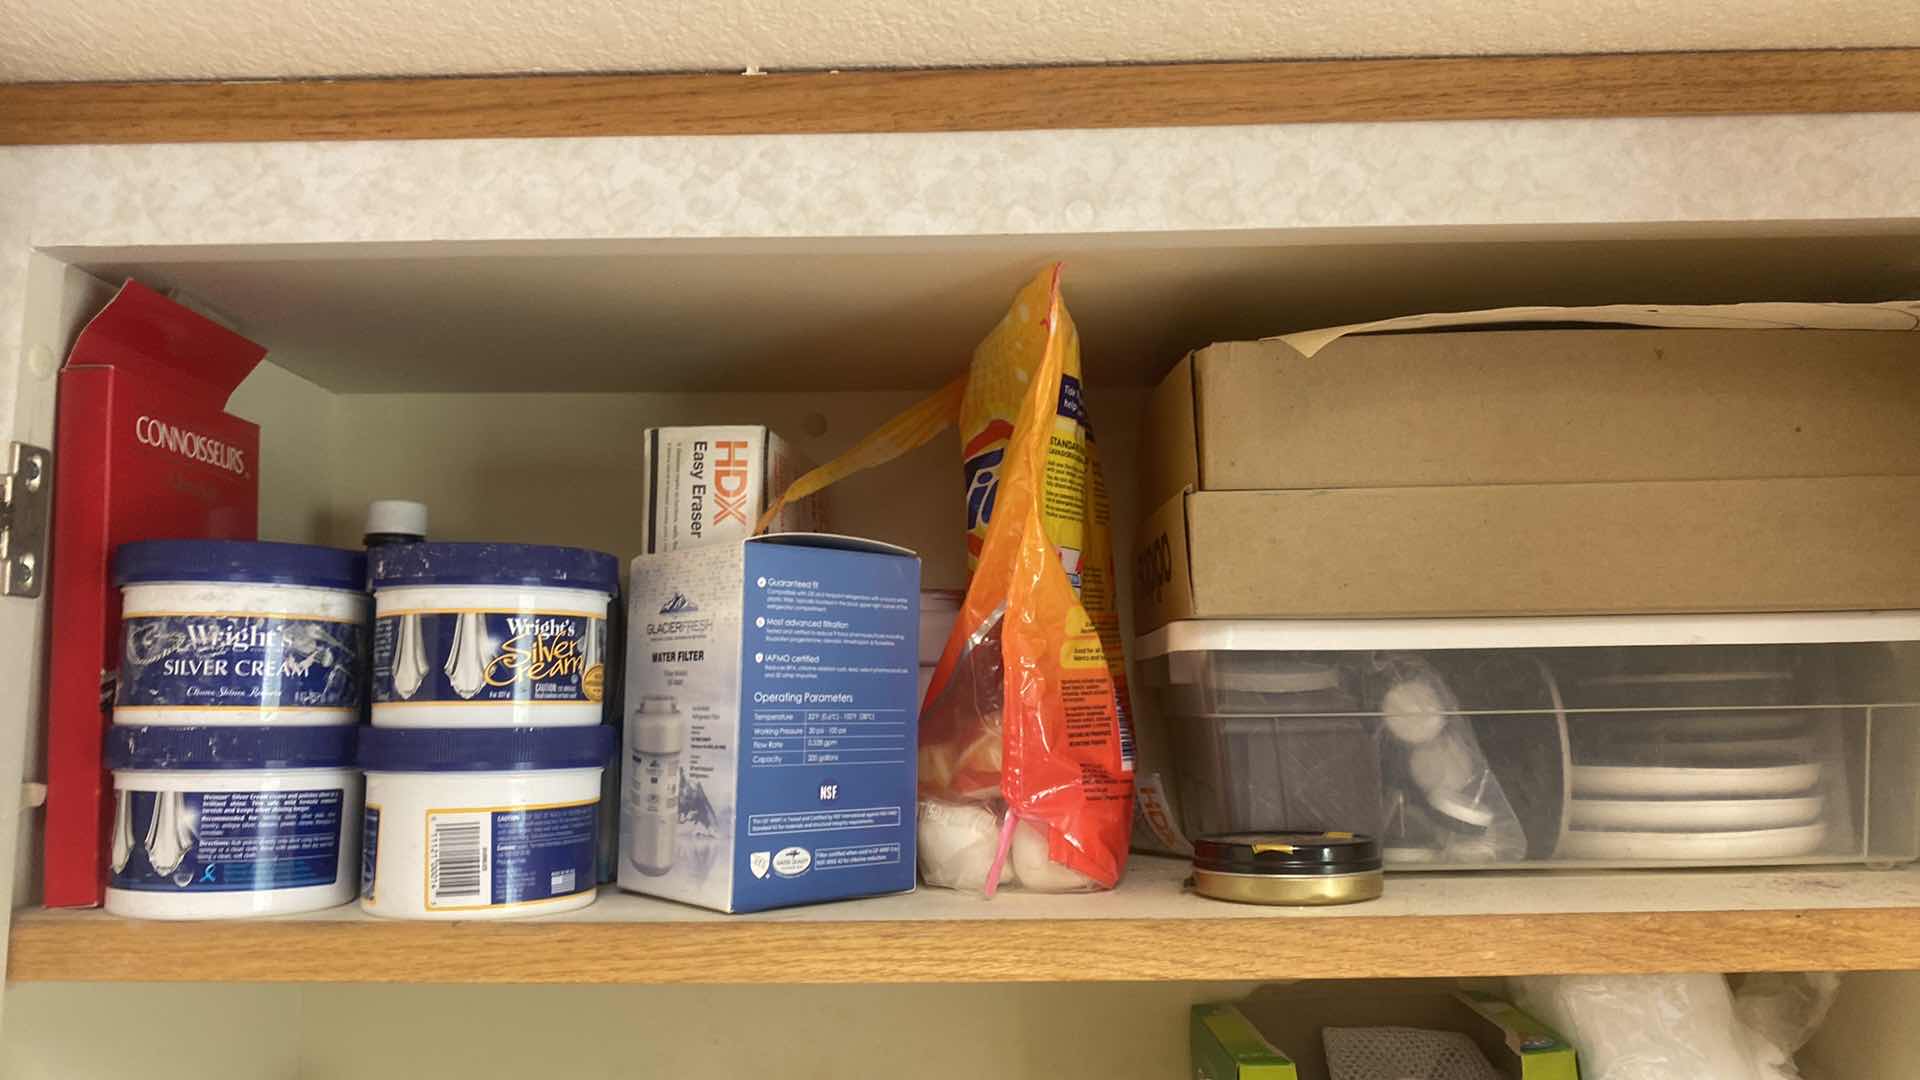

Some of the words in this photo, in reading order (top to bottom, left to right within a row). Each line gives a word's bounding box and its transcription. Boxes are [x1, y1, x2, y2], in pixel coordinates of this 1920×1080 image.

[136, 415, 245, 475] CONNOISSEURS
[689, 441, 708, 480] Easy
[713, 441, 748, 526] HDX
[690, 484, 707, 538] Eraser
[768, 577, 811, 589] Guaranteed
[506, 617, 575, 639] Wright's
[646, 619, 713, 636] GLACIERFRESH
[766, 617, 784, 626] Most
[785, 619, 822, 629] advanced
[823, 620, 849, 630] filtration
[186, 624, 292, 652] Wright's
[501, 632, 577, 664] Silver
[652, 651, 677, 663] WATER
[677, 650, 704, 662] FILTER
[791, 654, 820, 664] certified
[163, 659, 227, 677] SILVER
[235, 659, 309, 678] CREAM
[483, 653, 584, 687] Cream
[753, 691, 803, 705] Operating
[804, 691, 853, 704] Parameters
[754, 713, 794, 721] Temperature
[754, 728, 779, 737] Working
[779, 727, 804, 736] Pressure
[753, 741, 768, 749] Flow
[769, 741, 783, 749] Rate
[752, 755, 783, 765] Capacity
[820, 785, 838, 800] NSF
